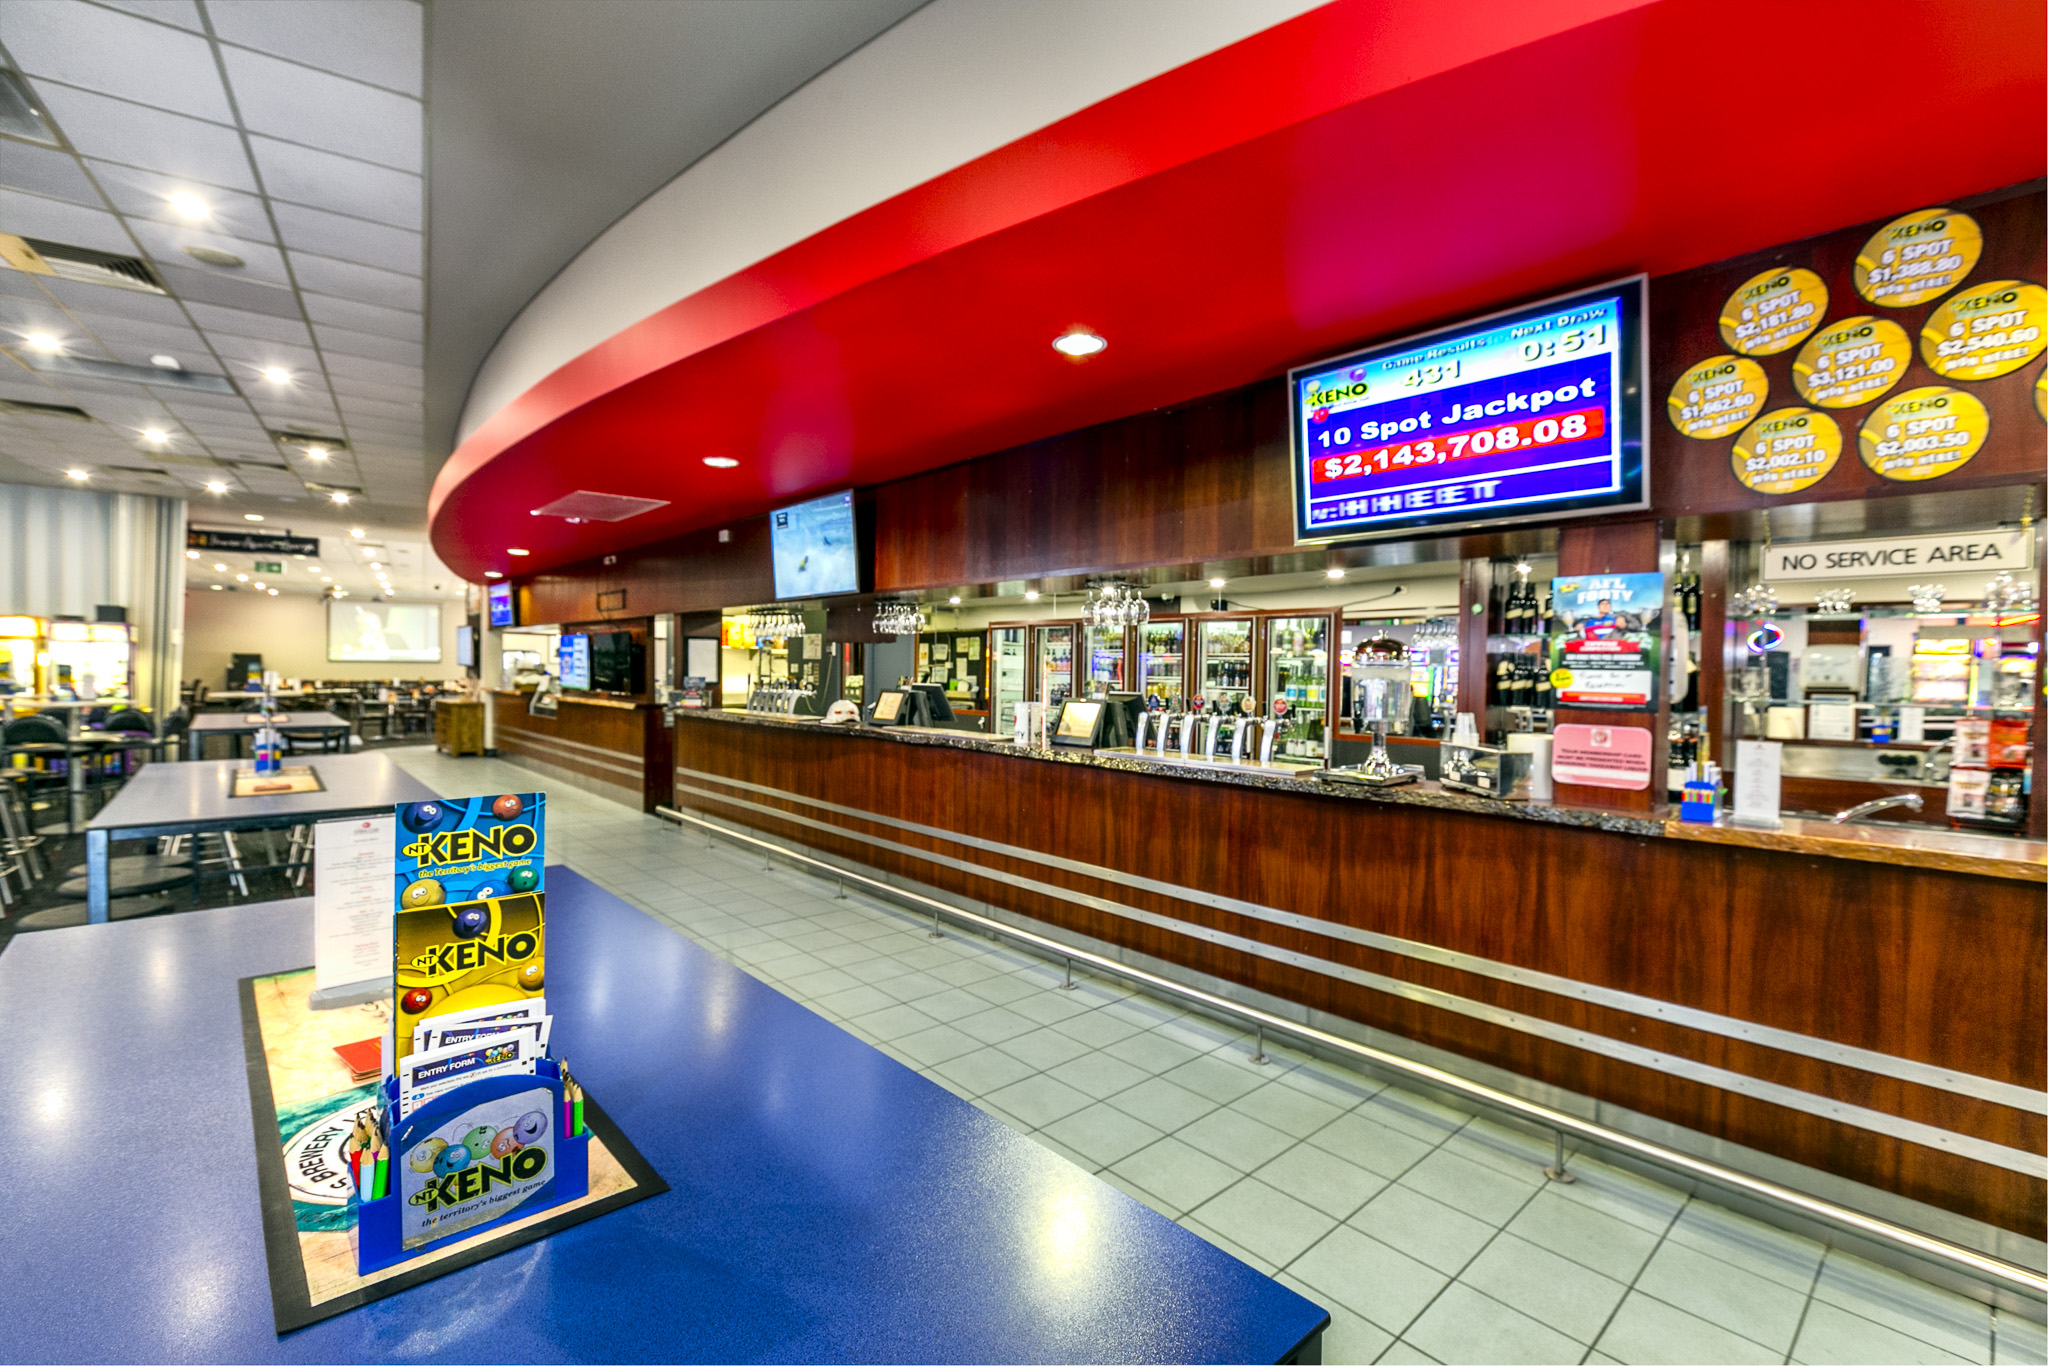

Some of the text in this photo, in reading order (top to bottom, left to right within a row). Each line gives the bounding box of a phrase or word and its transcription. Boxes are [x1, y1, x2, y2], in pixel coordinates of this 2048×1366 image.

[1881, 238, 1955, 265] 6 SPOT
[1741, 289, 1801, 321] 6 SPOT
[1511, 307, 1608, 339] Next Draw
[1949, 310, 2028, 337] 6 SPOT
[1427, 338, 1487, 360] Results
[1520, 323, 1607, 362] 0:51
[1816, 342, 1883, 370] 6 SPOT
[1402, 359, 1461, 389] 431
[1311, 381, 1369, 406] KENO
[1688, 379, 1745, 404] 6 SPOT
[1317, 376, 1596, 448] 10 Spot Jackpot
[1885, 415, 1959, 439] 6 SPOT
[1324, 414, 1588, 480] $2,143,708.08
[1755, 434, 1817, 455] 6 SPOT
[1782, 543, 2004, 571] NO SERVICE AREA
[1577, 589, 1634, 605] FOOTY
[1588, 577, 1627, 590] AFL
[408, 844, 427, 856] NT
[418, 824, 537, 868] KENO
[419, 859, 532, 878] the Territory's biggest game
[416, 931, 539, 978] NT KENO
[445, 1034, 474, 1044] ENTRY
[418, 1057, 476, 1079] ENTRY FORM
[299, 1126, 344, 1183] BREWERY
[415, 1146, 547, 1213] NT KENO
[422, 1179, 546, 1228] the territory's biggest game
